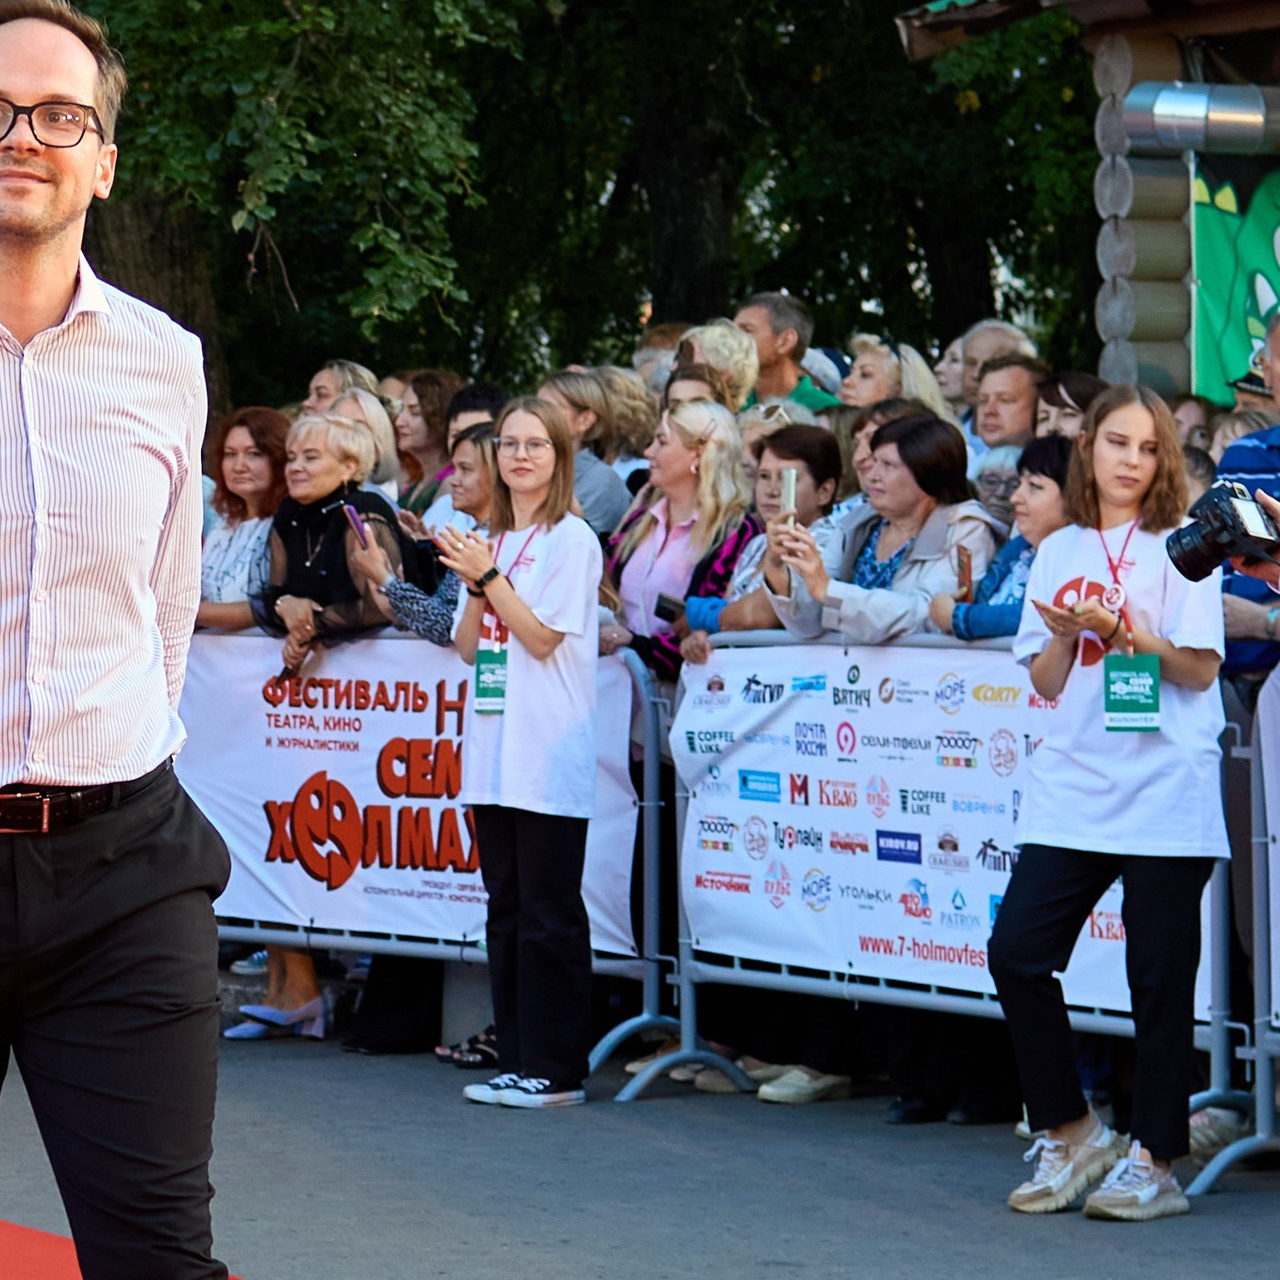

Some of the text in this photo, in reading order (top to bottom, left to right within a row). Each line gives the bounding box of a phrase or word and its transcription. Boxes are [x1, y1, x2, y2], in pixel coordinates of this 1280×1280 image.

[263, 676, 429, 712] ФЕСТИВАЛЬ
[833, 687, 871, 708] ВЯТИЧ
[935, 679, 965, 704] МОРЕ
[266, 713, 362, 733] ТЕАТРА, КИНО
[795, 722, 826, 738] ПОЧТА
[698, 731, 735, 742] COFFEE
[277, 738, 360, 752] ЖУРНАЛИСТИКИ
[796, 740, 827, 756] РОССИИ
[911, 790, 946, 804] COFFEE
[911, 804, 931, 816] LIKE
[801, 876, 831, 899] МОРЕ
[941, 911, 982, 927] PATRON
